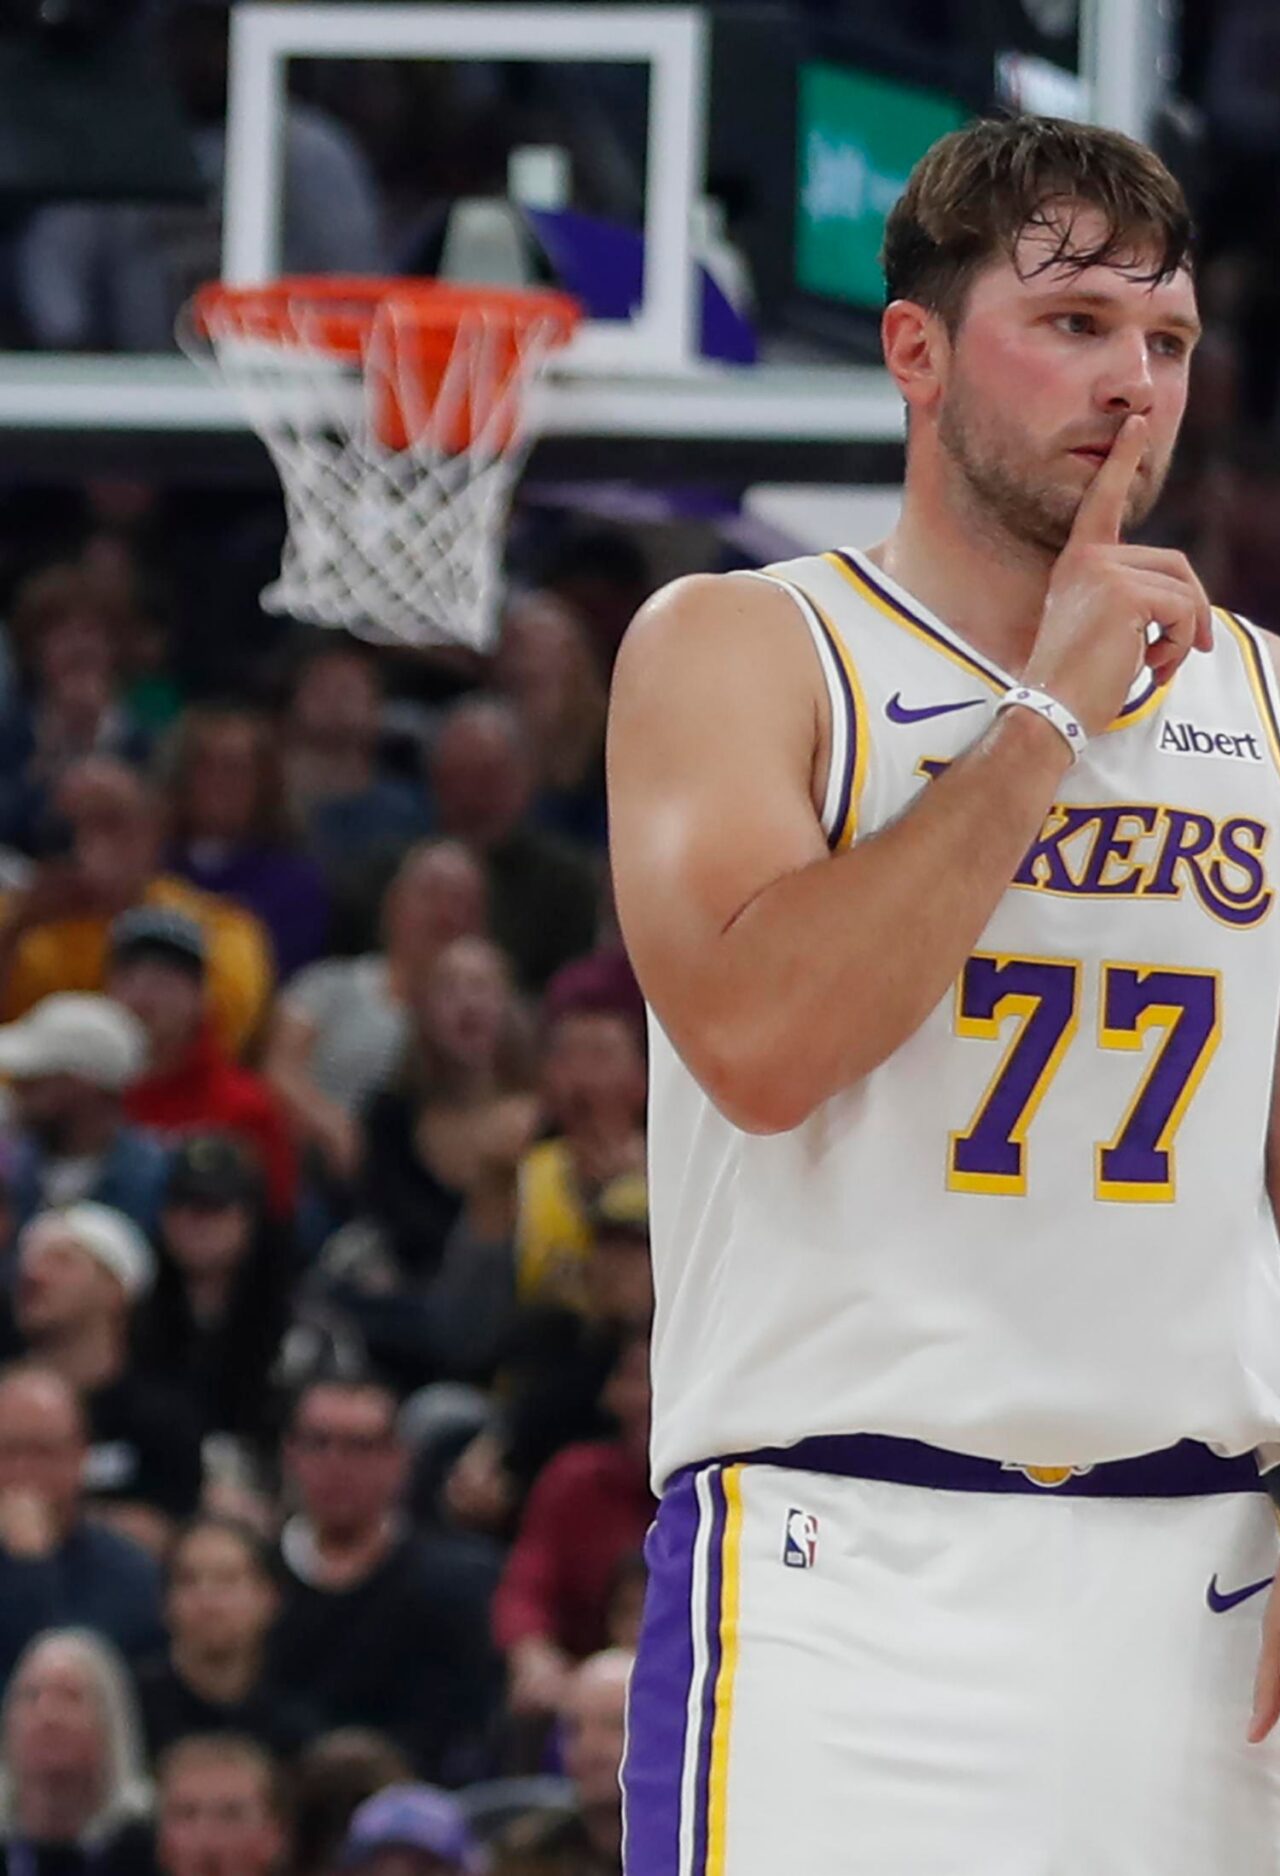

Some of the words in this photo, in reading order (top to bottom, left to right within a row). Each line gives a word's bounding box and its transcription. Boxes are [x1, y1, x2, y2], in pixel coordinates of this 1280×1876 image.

[1160, 720, 1262, 760] Albert
[915, 757, 1275, 930] KERS
[946, 950, 1222, 1203] 77
